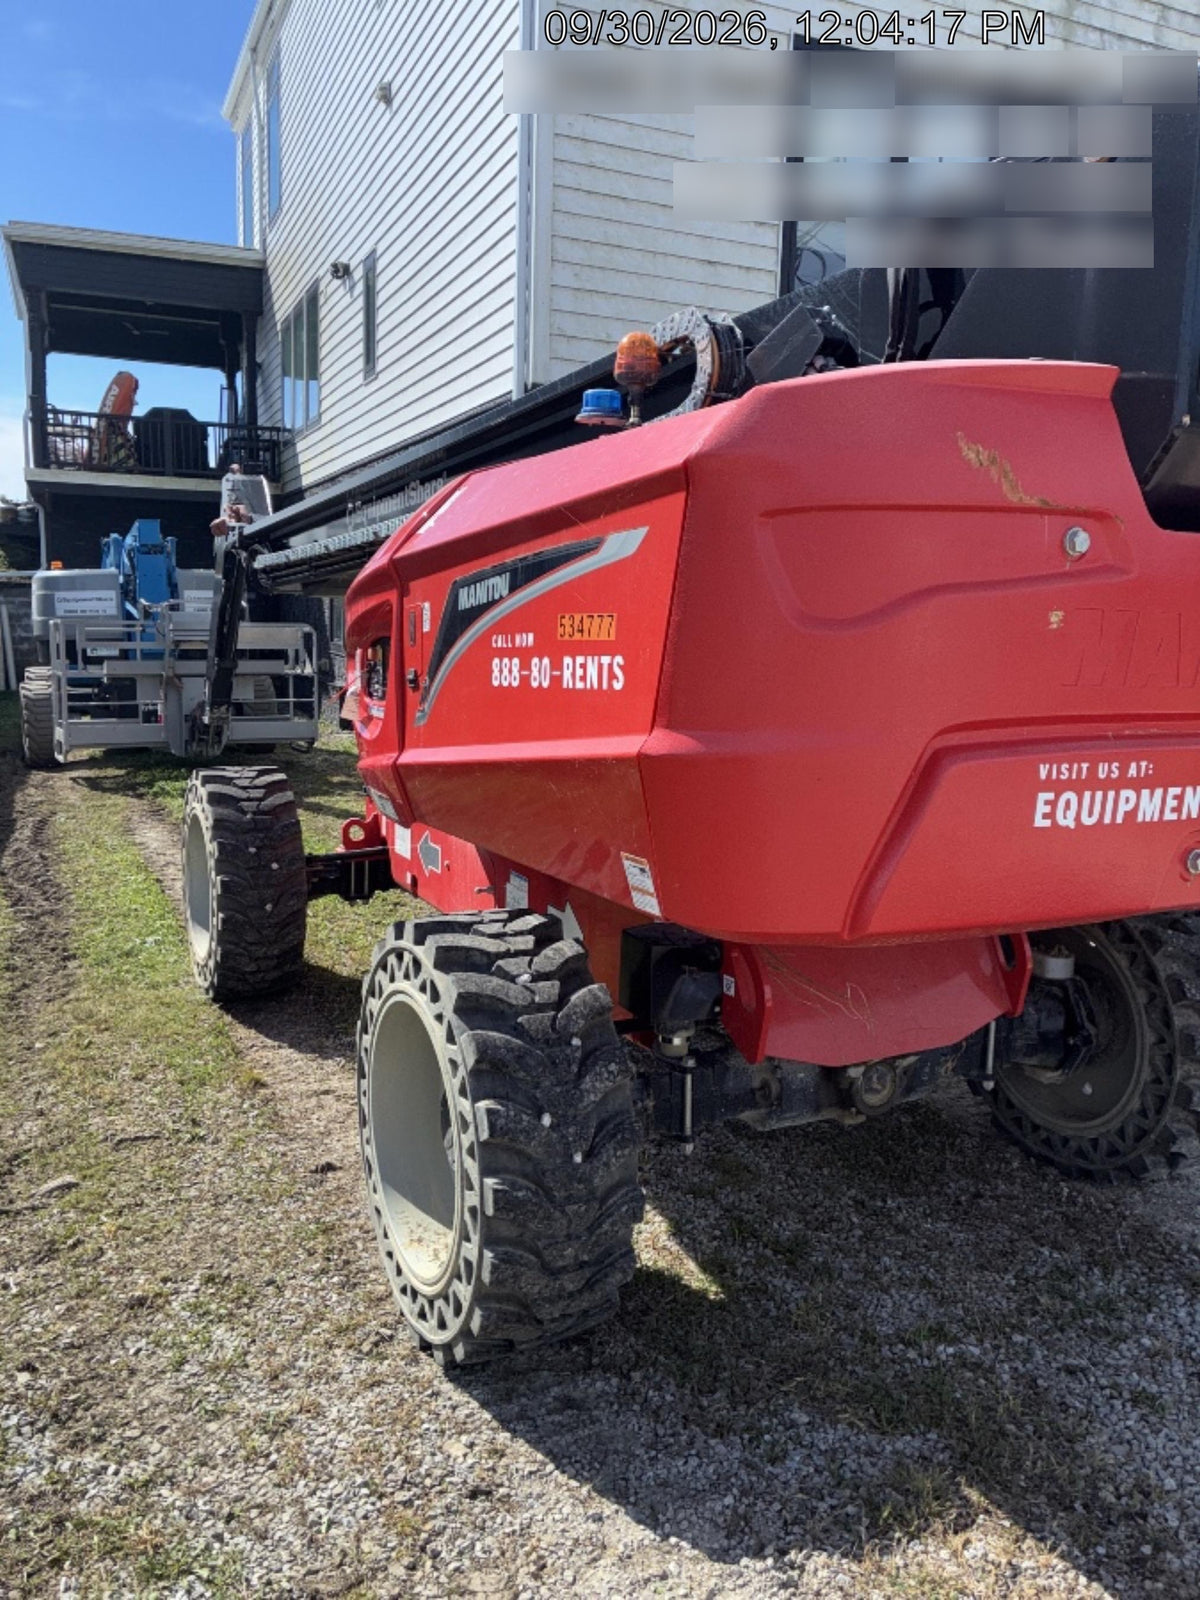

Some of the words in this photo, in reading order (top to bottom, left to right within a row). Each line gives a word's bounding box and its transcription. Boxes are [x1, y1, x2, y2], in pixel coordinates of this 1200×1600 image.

[458, 572, 510, 611] MANITOU
[559, 614, 615, 639] 534777
[492, 634, 513, 648] CALL
[515, 632, 534, 648] NOW
[491, 654, 625, 691] 888-80-RENTS
[1039, 763, 1090, 780] VISIT
[1098, 762, 1120, 779] US
[1127, 760, 1153, 778] AT:
